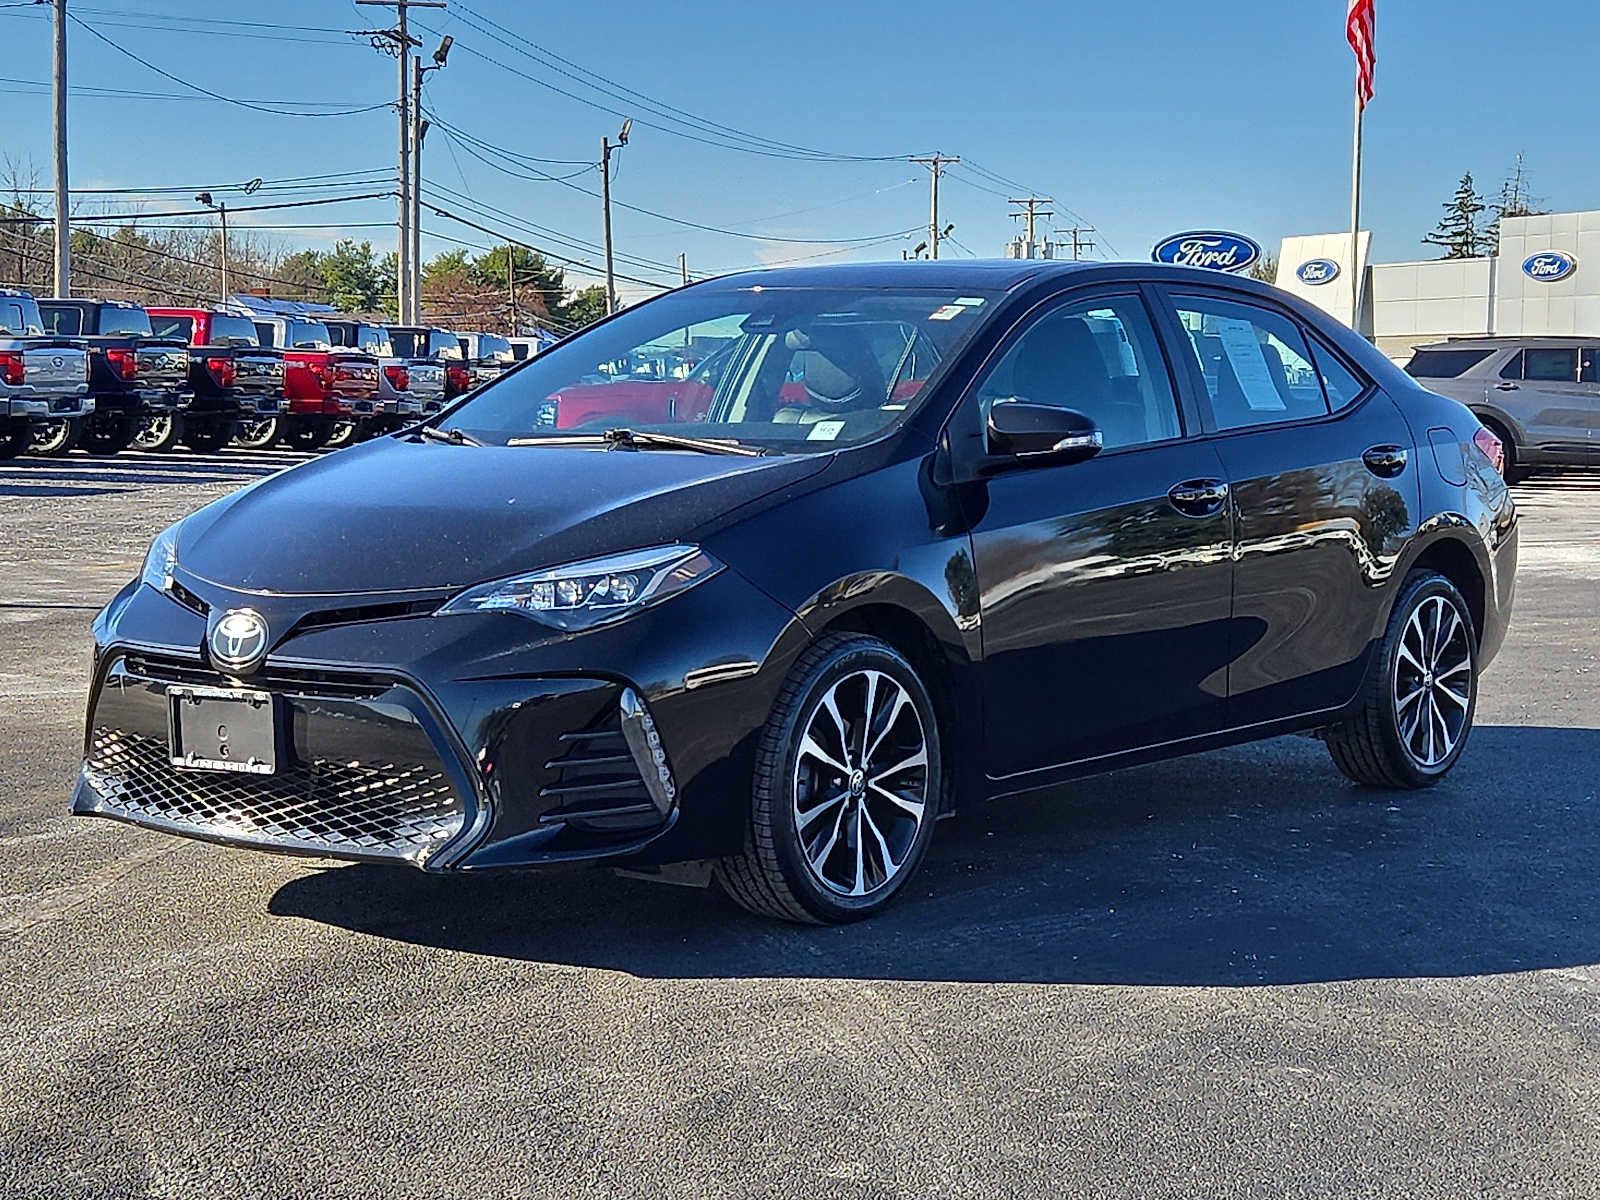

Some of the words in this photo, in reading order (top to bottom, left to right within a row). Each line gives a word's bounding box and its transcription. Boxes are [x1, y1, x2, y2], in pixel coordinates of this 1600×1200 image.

[1174, 240, 1238, 266] Ford
[1303, 264, 1328, 279] Ford
[1531, 257, 1561, 275] Ford
